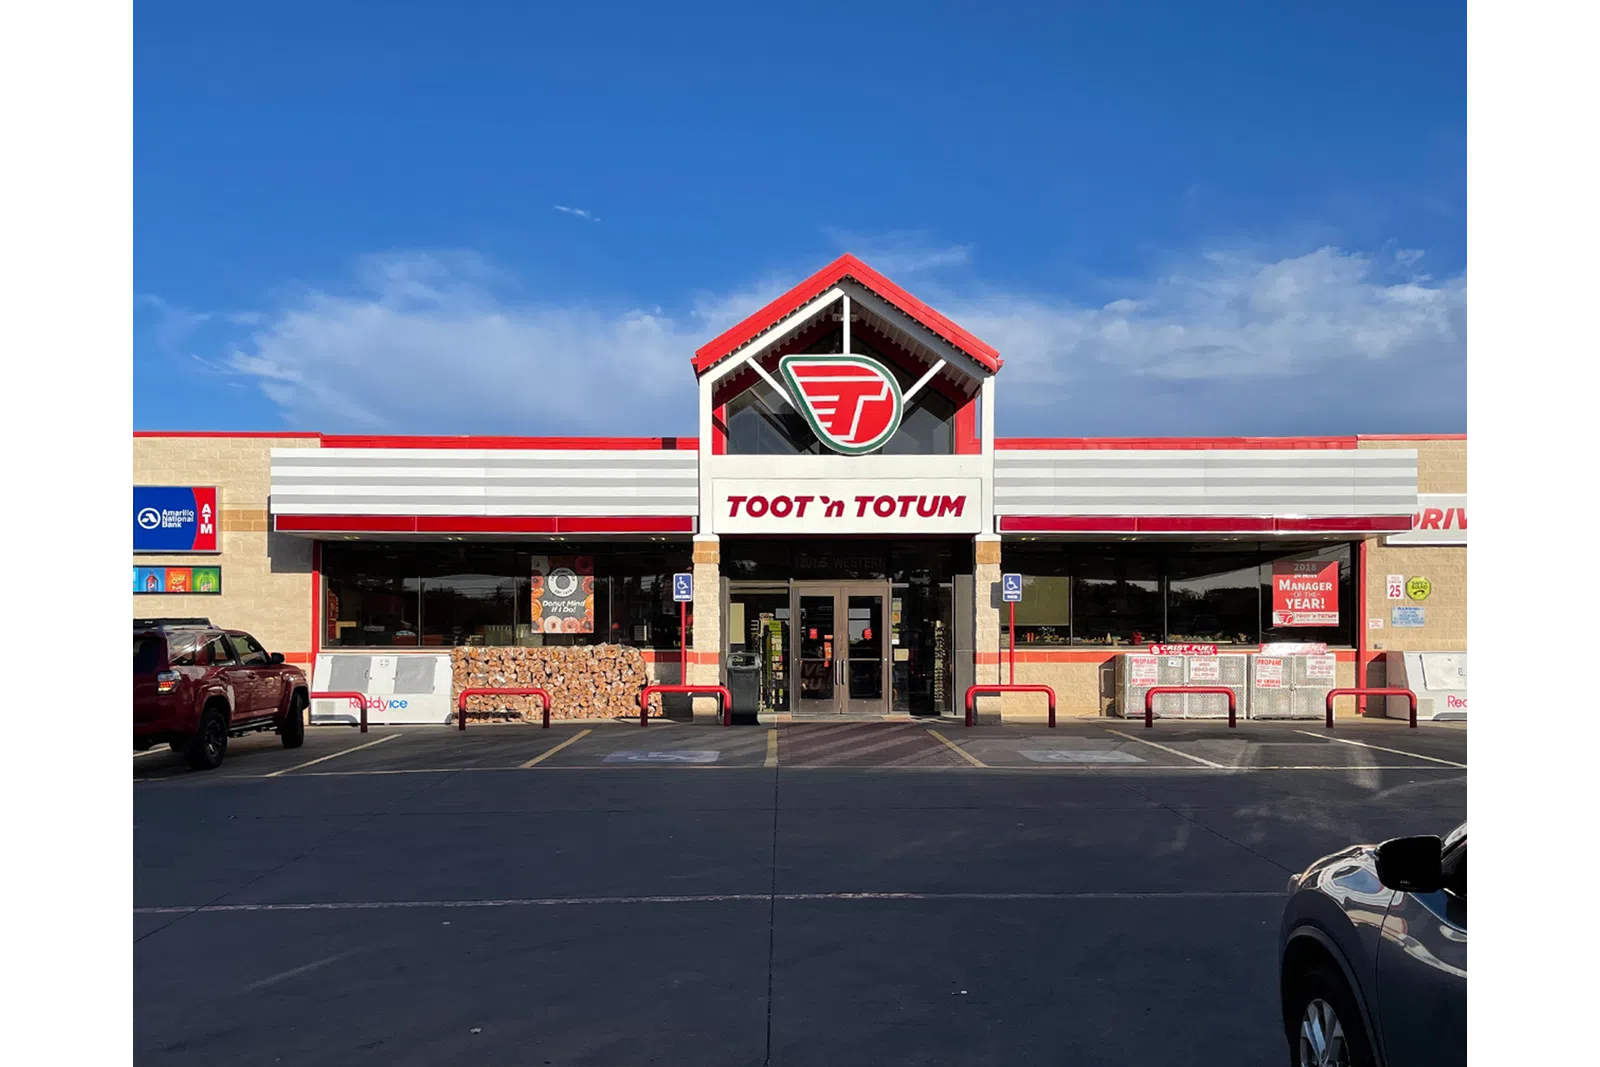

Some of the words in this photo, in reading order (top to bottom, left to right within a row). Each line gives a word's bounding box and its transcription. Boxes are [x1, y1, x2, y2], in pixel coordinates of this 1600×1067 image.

[727, 495, 815, 518] TOOT
[854, 495, 967, 518] TOTUM
[162, 509, 195, 517] Amarillo
[162, 514, 194, 522] National
[200, 503, 213, 534] ATM
[832, 556, 885, 568] WESTERN
[1279, 579, 1333, 591] MANAGER
[1389, 584, 1401, 598] 25
[1285, 598, 1325, 610] YEAR!
